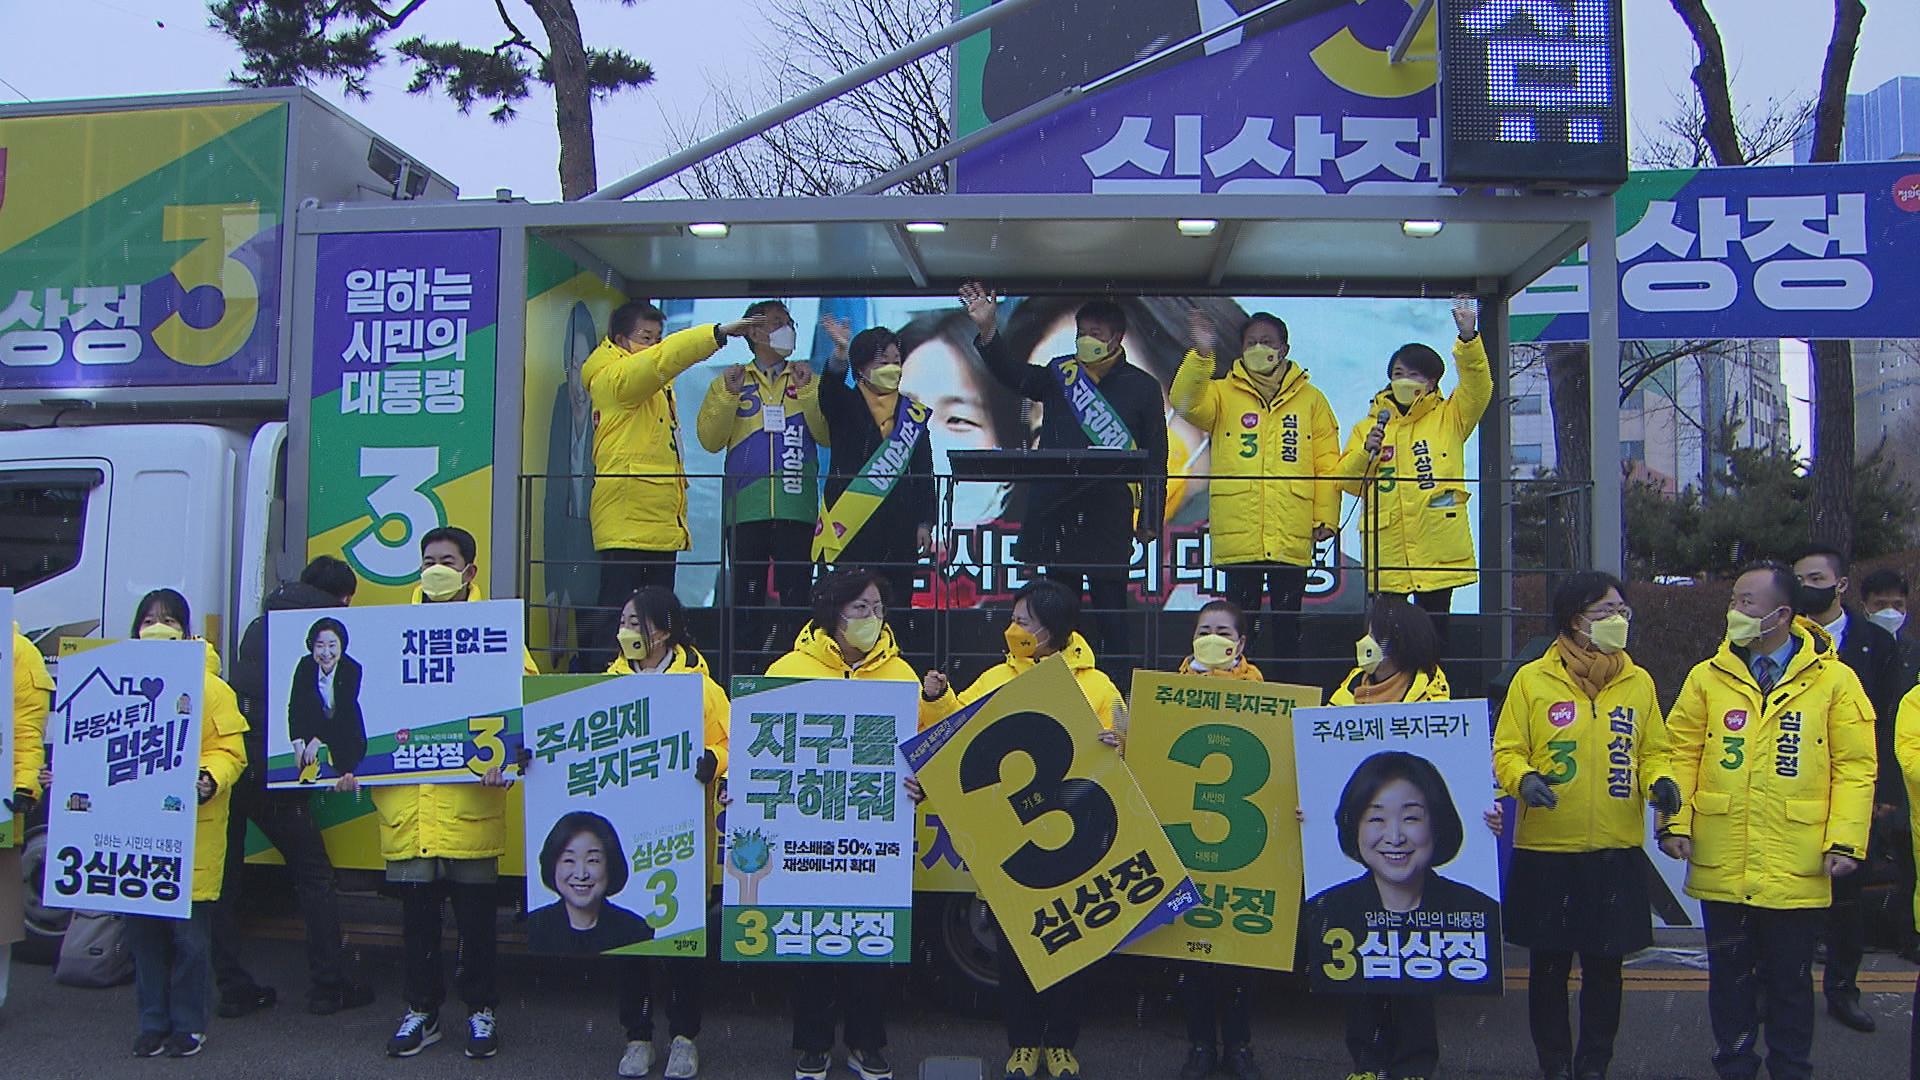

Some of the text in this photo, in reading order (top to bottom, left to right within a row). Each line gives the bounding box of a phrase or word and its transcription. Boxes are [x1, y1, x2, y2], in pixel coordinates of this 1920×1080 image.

[346, 268, 472, 313] 일하는
[342, 318, 467, 363] 시민의
[340, 369, 464, 415] 대통령
[736, 384, 761, 417] 3
[1239, 433, 1258, 459] 3
[1281, 414, 1298, 462] 심상정
[1378, 466, 1396, 493] 3
[1412, 440, 1436, 490] 심상정
[350, 446, 440, 578] 3
[402, 657, 455, 684] 나라
[72, 701, 155, 742] 부동산 투기
[1155, 685, 1297, 718] 주4일제 복지국가
[466, 716, 506, 775] 3
[536, 696, 650, 764] 주4일제
[748, 713, 898, 766] 지구를
[1312, 713, 1469, 743] 주4일제 복지국가
[1775, 711, 1801, 778] 심상정
[107, 718, 190, 787] 멈춰!
[392, 743, 464, 769] 심상정
[567, 730, 693, 796] 복지국가
[1548, 740, 1577, 785] 3
[1607, 705, 1634, 799] 심상정
[1720, 736, 1745, 770] 3
[747, 769, 897, 822] 구해줘
[960, 711, 1118, 889] 3
[1161, 724, 1271, 872] 3
[125, 835, 153, 850] 시민의
[632, 830, 694, 872] 심상정
[782, 858, 875, 873] 재생에너지 확대
[784, 840, 835, 855] 탄소배출
[837, 838, 872, 855] 50%
[646, 869, 679, 929] 3
[1031, 850, 1164, 955] 심상정
[1365, 911, 1485, 928] 일하는 시민의 대통령
[772, 911, 894, 957] 심상정
[1357, 931, 1488, 981] 심상정
